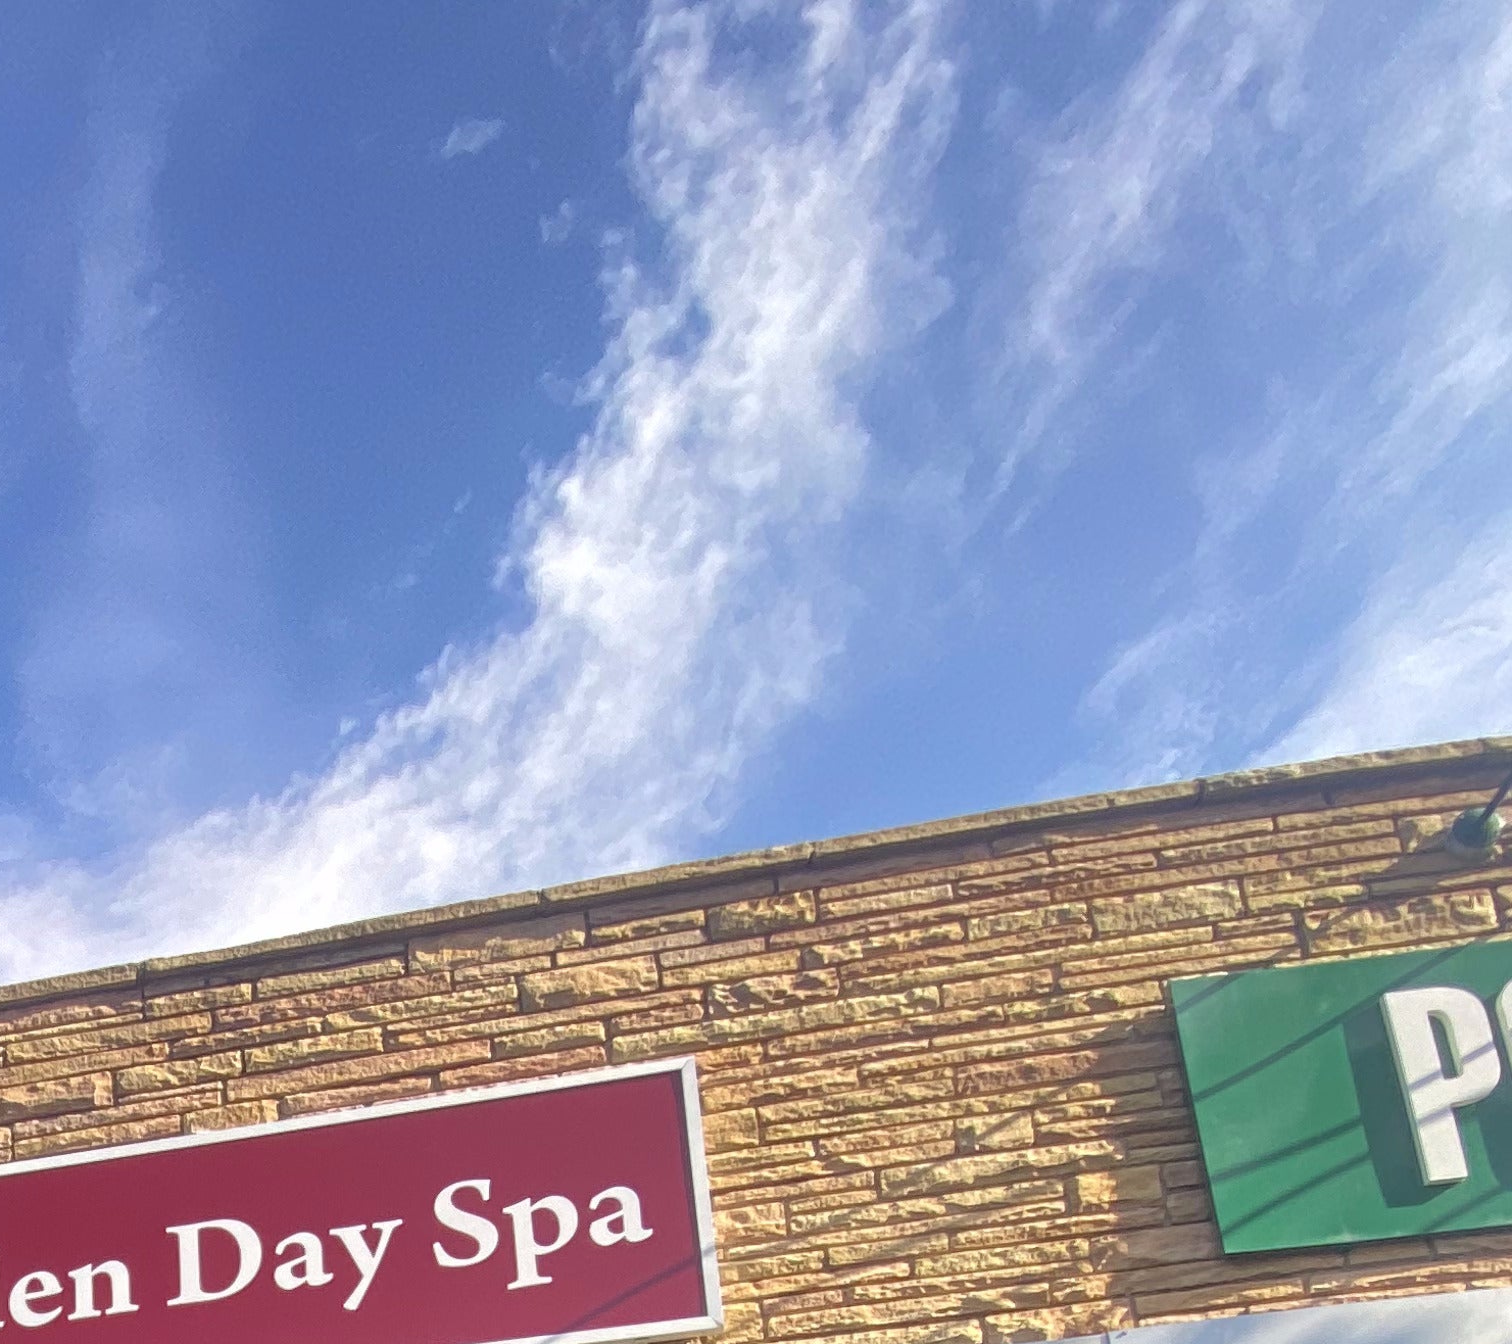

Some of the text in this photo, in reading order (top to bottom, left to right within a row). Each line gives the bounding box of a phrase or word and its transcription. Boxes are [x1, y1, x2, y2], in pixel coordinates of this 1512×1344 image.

[1384, 980, 1512, 1186] P
[166, 1218, 402, 1310] Day
[433, 1179, 654, 1290] Spa
